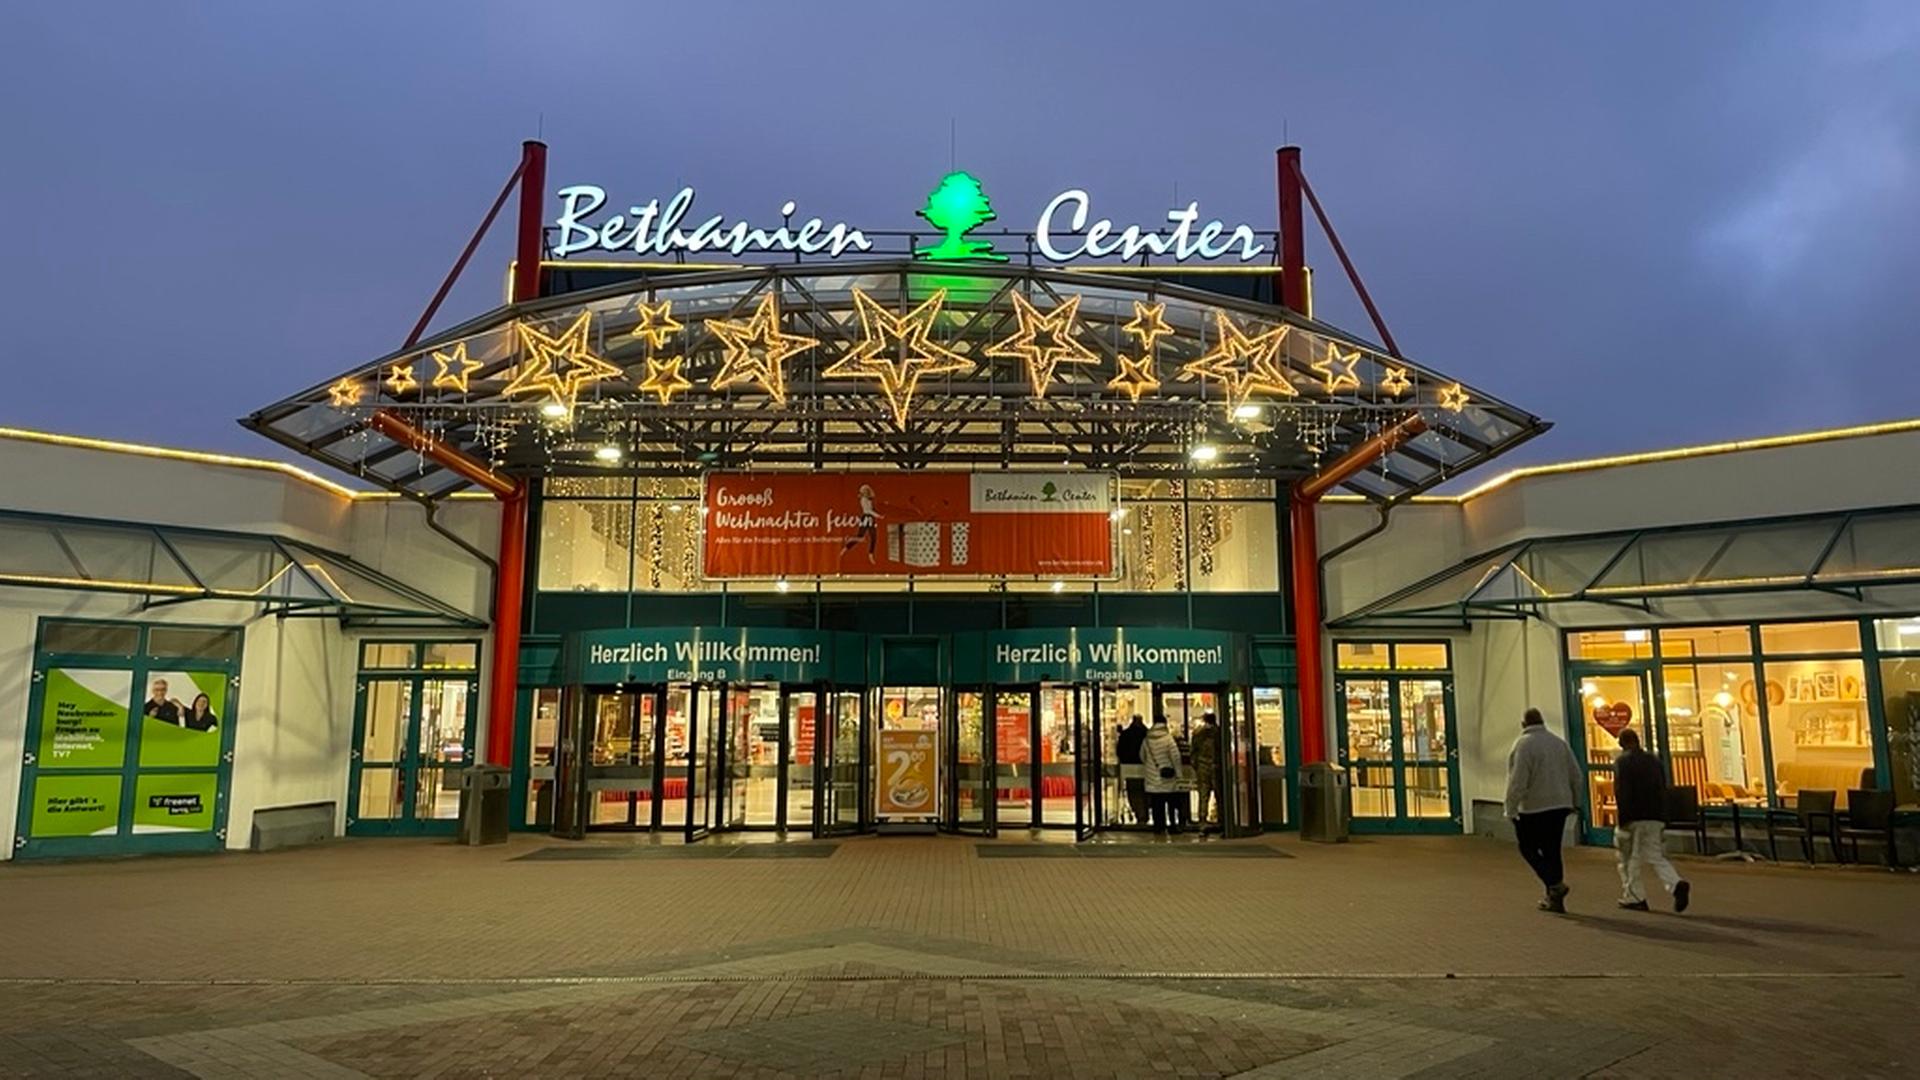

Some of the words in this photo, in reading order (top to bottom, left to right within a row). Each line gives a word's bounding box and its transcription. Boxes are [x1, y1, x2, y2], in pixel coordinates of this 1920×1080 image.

[552, 184, 873, 258] Bethanien
[1036, 189, 1265, 262] Center
[985, 487, 1038, 502] Bethanien
[1062, 488, 1097, 501] Center
[715, 510, 819, 531] Weihnachten
[591, 642, 668, 665] Herzlich
[675, 642, 820, 664] Willkommen!
[996, 643, 1082, 664] Herzlich
[1089, 643, 1223, 665] Willkommen!
[1085, 668, 1132, 681] Eingang
[1135, 668, 1144, 680] B
[53, 750, 71, 758] TV?
